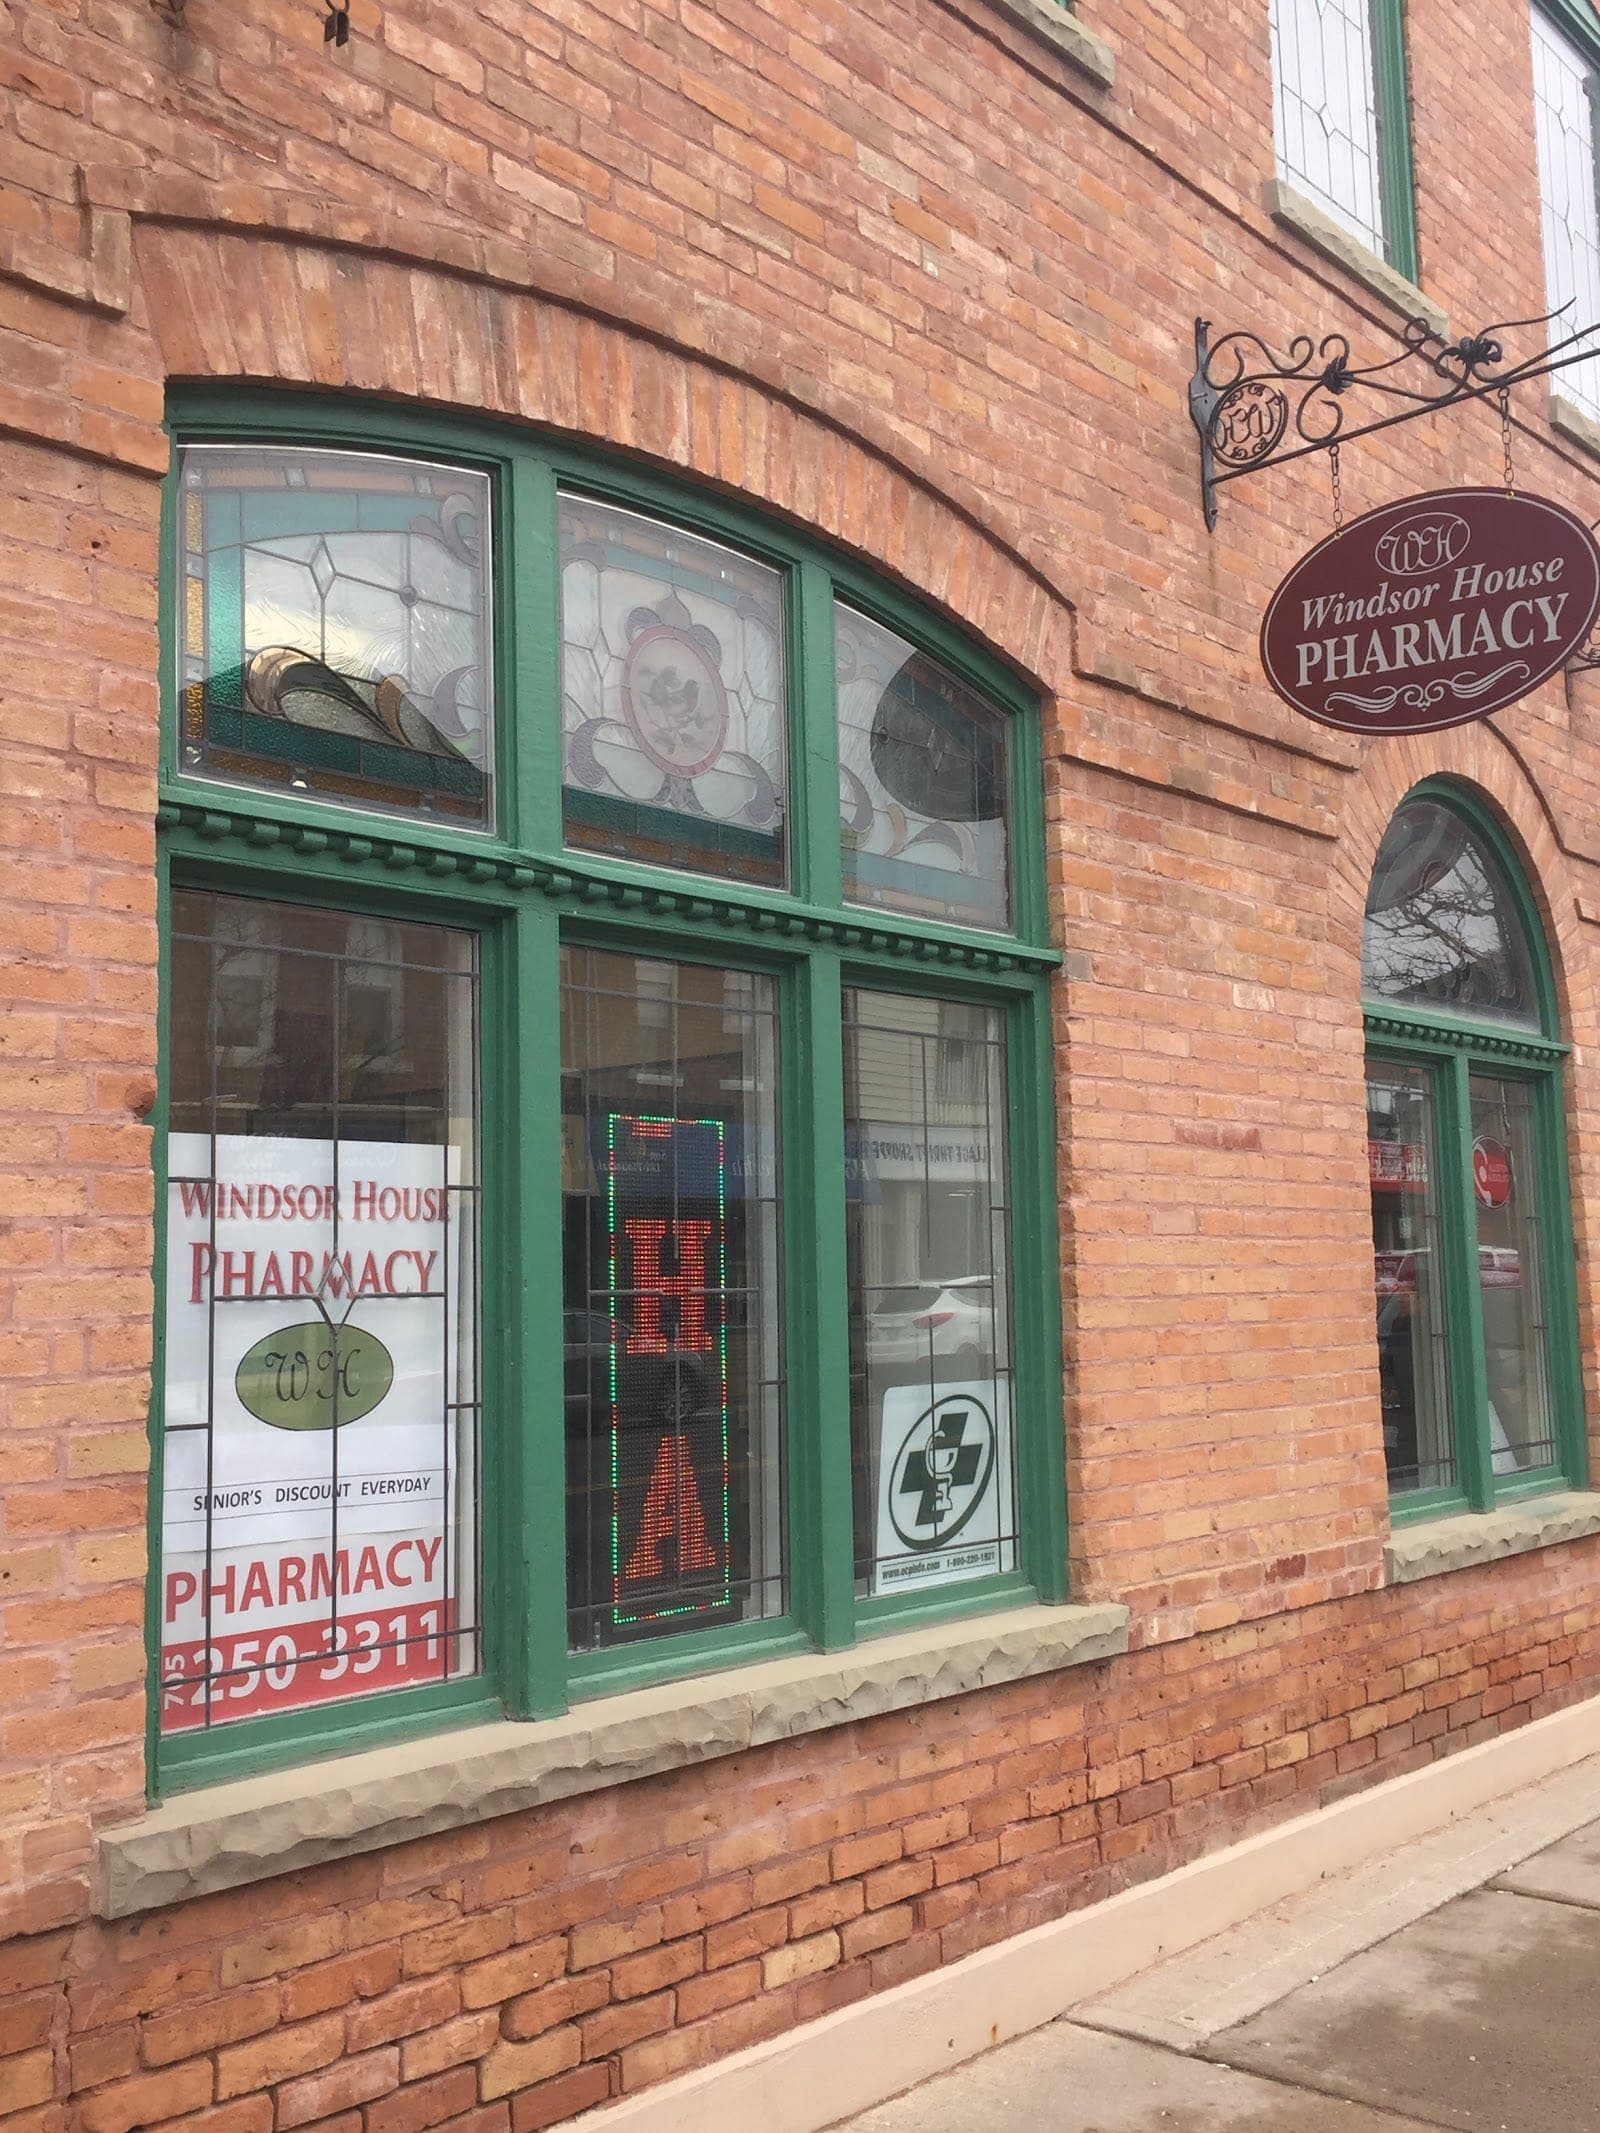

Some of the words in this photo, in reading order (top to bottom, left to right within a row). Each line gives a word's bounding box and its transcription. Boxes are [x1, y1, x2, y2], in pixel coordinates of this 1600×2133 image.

[1301, 579, 1440, 632] Windsor
[1449, 555, 1565, 602] House
[1295, 593, 1570, 687] PHARMACY
[178, 1181, 343, 1222] WINDSOR
[352, 1180, 451, 1222] HOUSE
[188, 1241, 438, 1304] PHARMACY
[275, 1483, 352, 1503] DISCOUNT
[361, 1477, 431, 1497] EVERYDAY
[165, 1536, 443, 1624] PHARMACY
[190, 1609, 438, 1707] 250-3311
